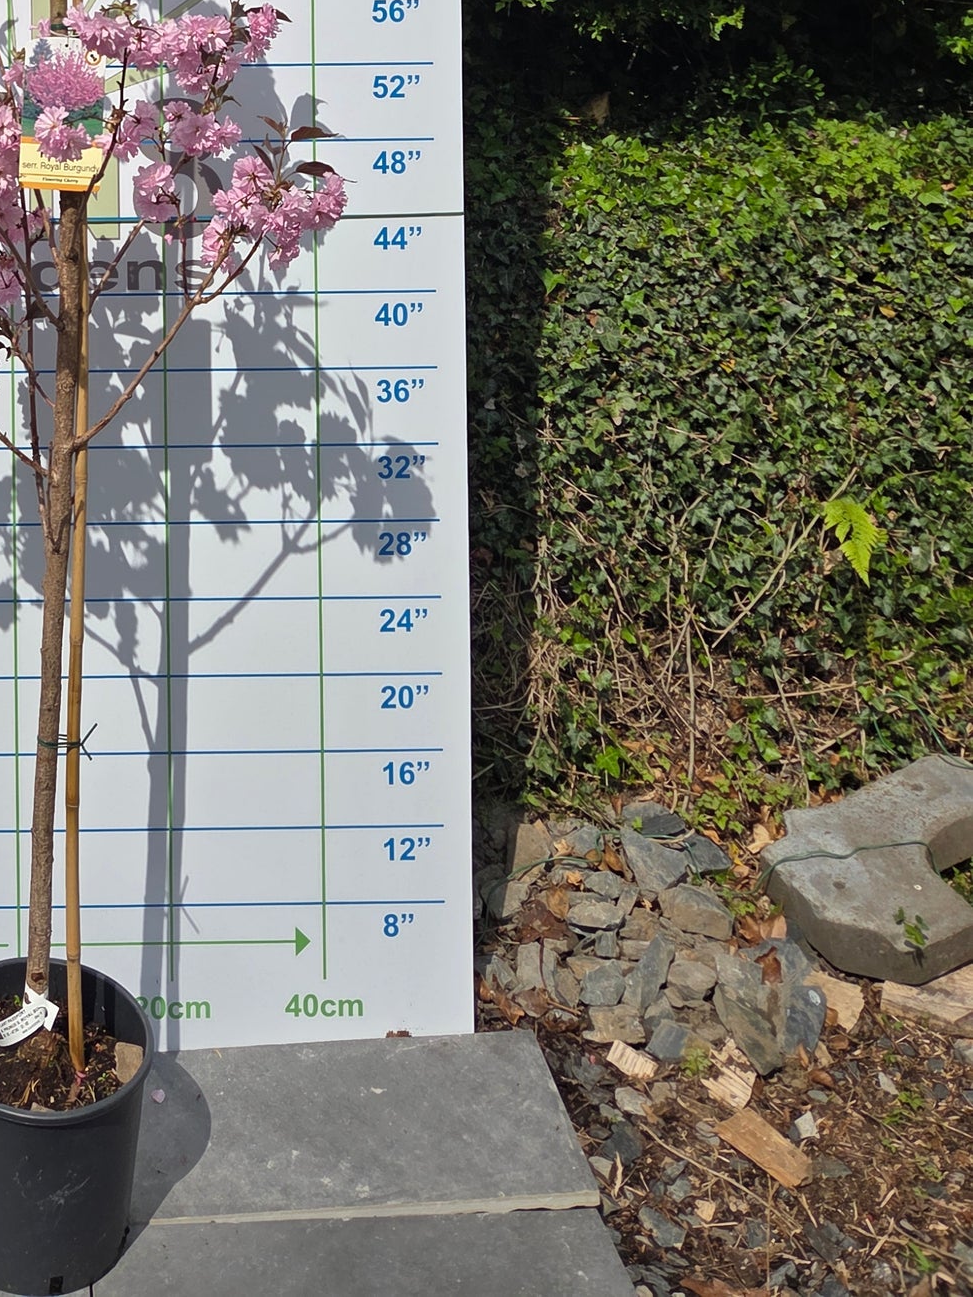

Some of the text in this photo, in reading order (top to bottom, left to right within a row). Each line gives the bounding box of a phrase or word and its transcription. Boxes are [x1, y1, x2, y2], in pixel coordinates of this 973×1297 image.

[22, 162, 100, 174] serr. Royal Burgundy
[284, 993, 364, 1017] 40cm
